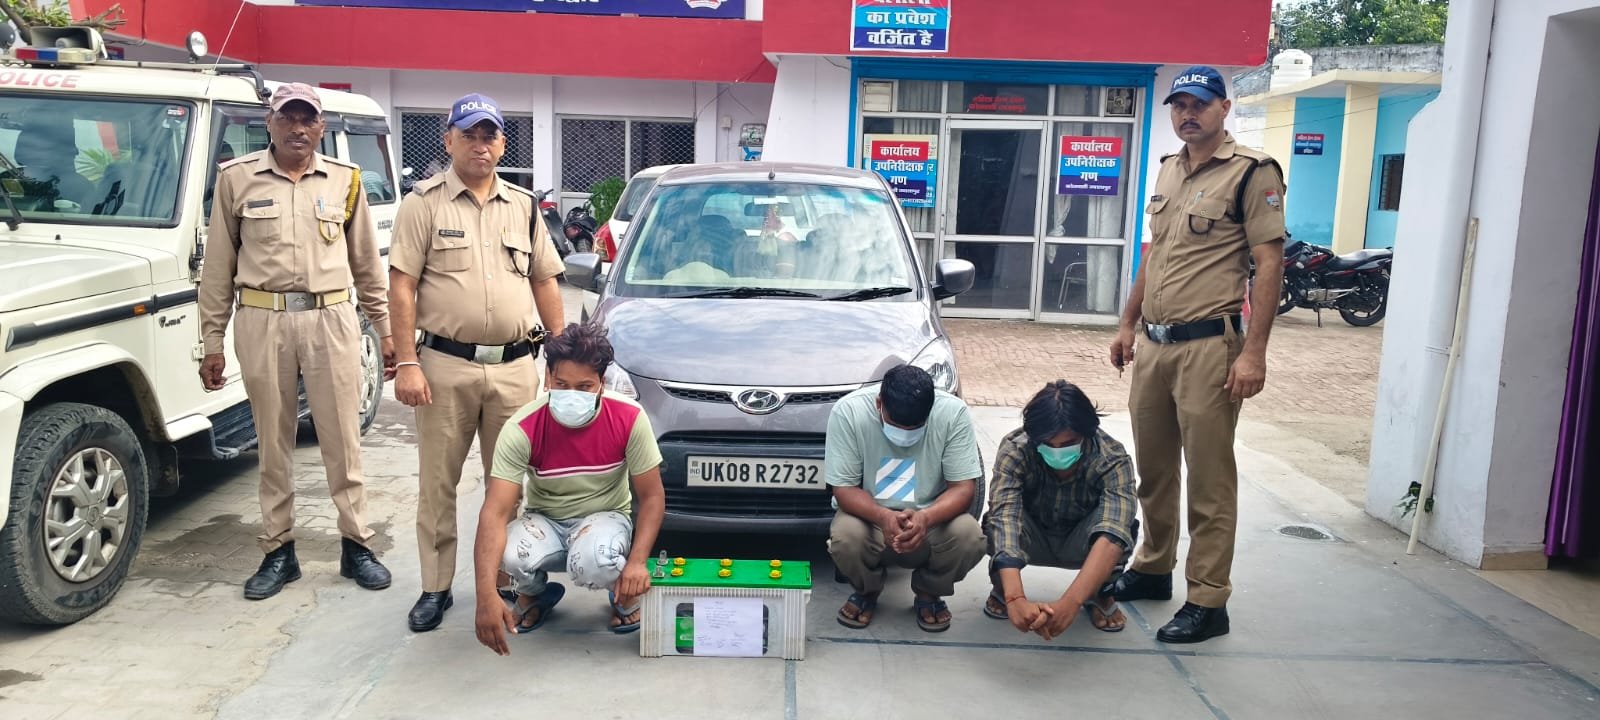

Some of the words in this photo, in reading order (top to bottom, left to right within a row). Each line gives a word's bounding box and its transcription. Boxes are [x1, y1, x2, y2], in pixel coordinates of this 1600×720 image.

[866, 11, 892, 24] का
[894, 8, 937, 25] प्रवेश
[866, 29, 917, 45] वर्जित
[917, 29, 934, 46] है
[0, 71, 81, 88] OLICE
[1173, 73, 1209, 88] POLICE
[880, 144, 921, 157] कार्यालय
[1070, 139, 1114, 153] कार्यालय
[873, 159, 925, 172] उपनिरीक्षक
[1063, 154, 1118, 168] उपनिरीक्षक
[889, 175, 908, 185] गण
[1080, 171, 1099, 181] गण
[701, 462, 750, 482] UK08
[756, 463, 819, 484] R2732
